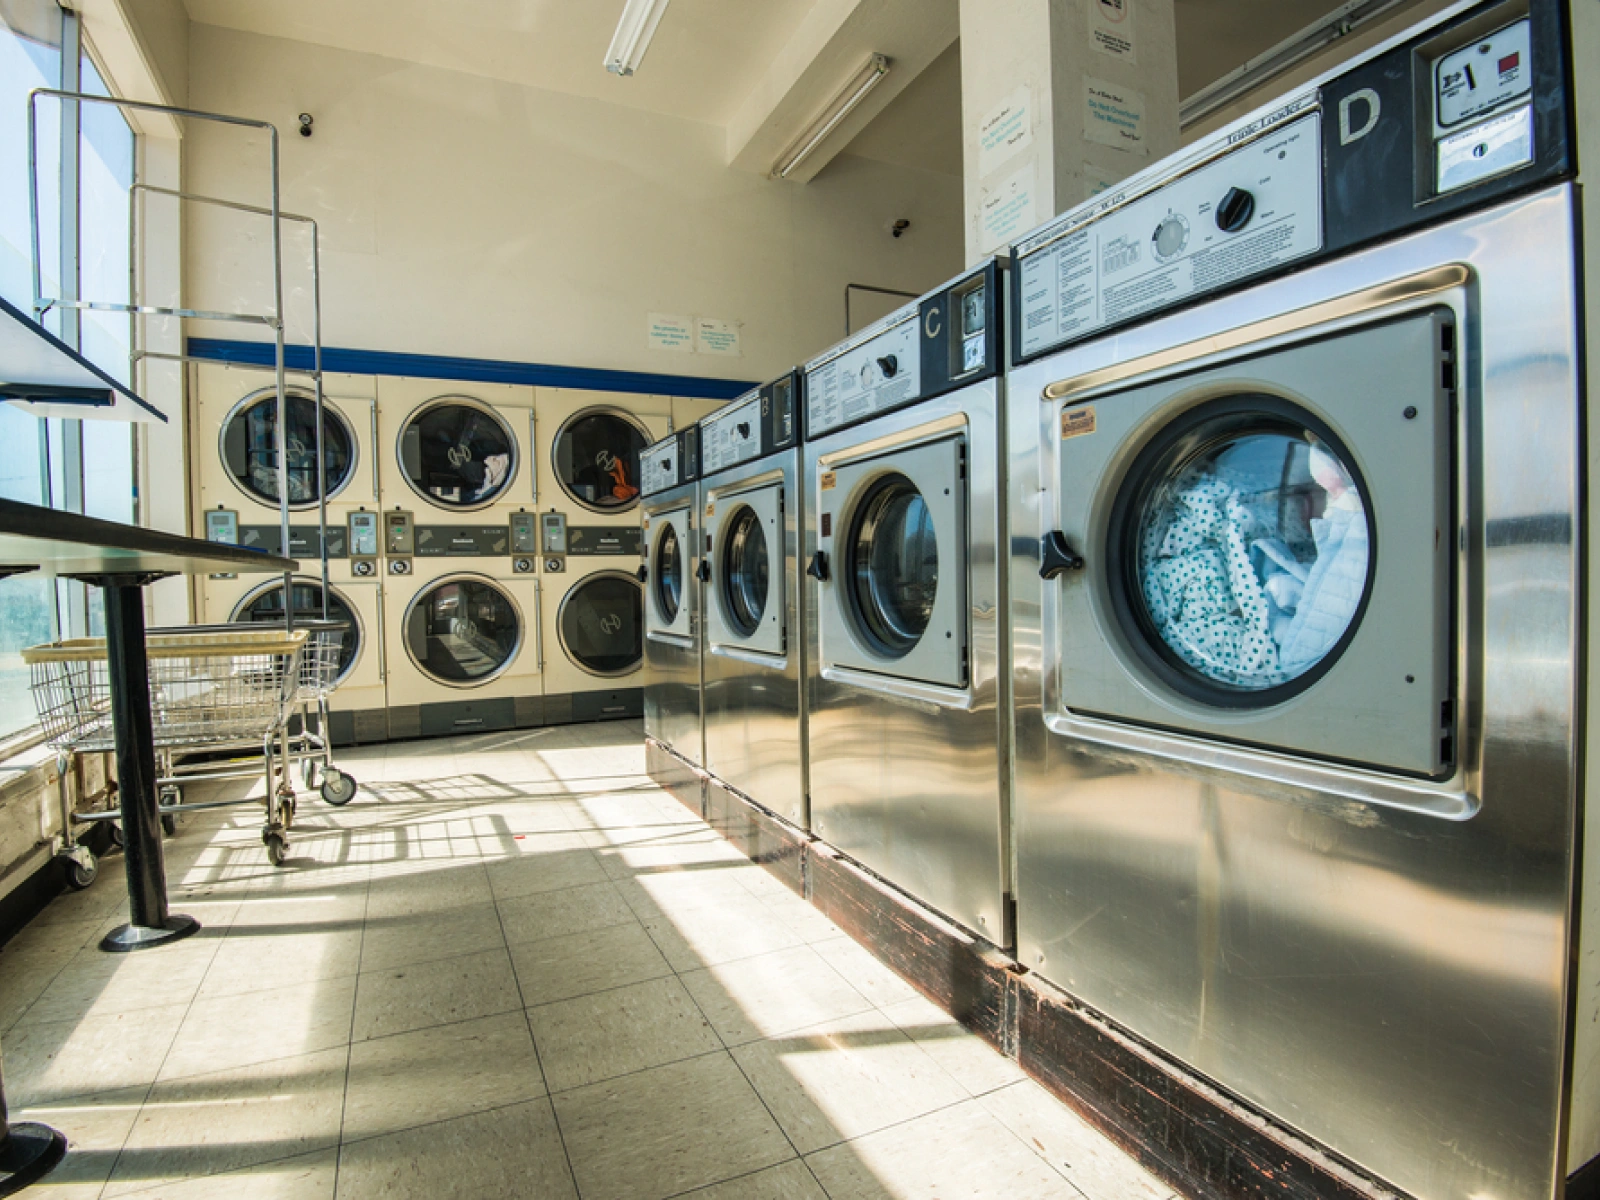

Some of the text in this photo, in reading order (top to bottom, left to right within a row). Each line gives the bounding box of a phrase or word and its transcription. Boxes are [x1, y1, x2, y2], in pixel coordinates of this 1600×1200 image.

[1093, 110, 1105, 120] The
[1098, 101, 1110, 111] Not
[1339, 87, 1381, 146] D
[1226, 102, 1302, 145] Triple Loader
[925, 307, 941, 338] C
[762, 396, 769, 417] B
